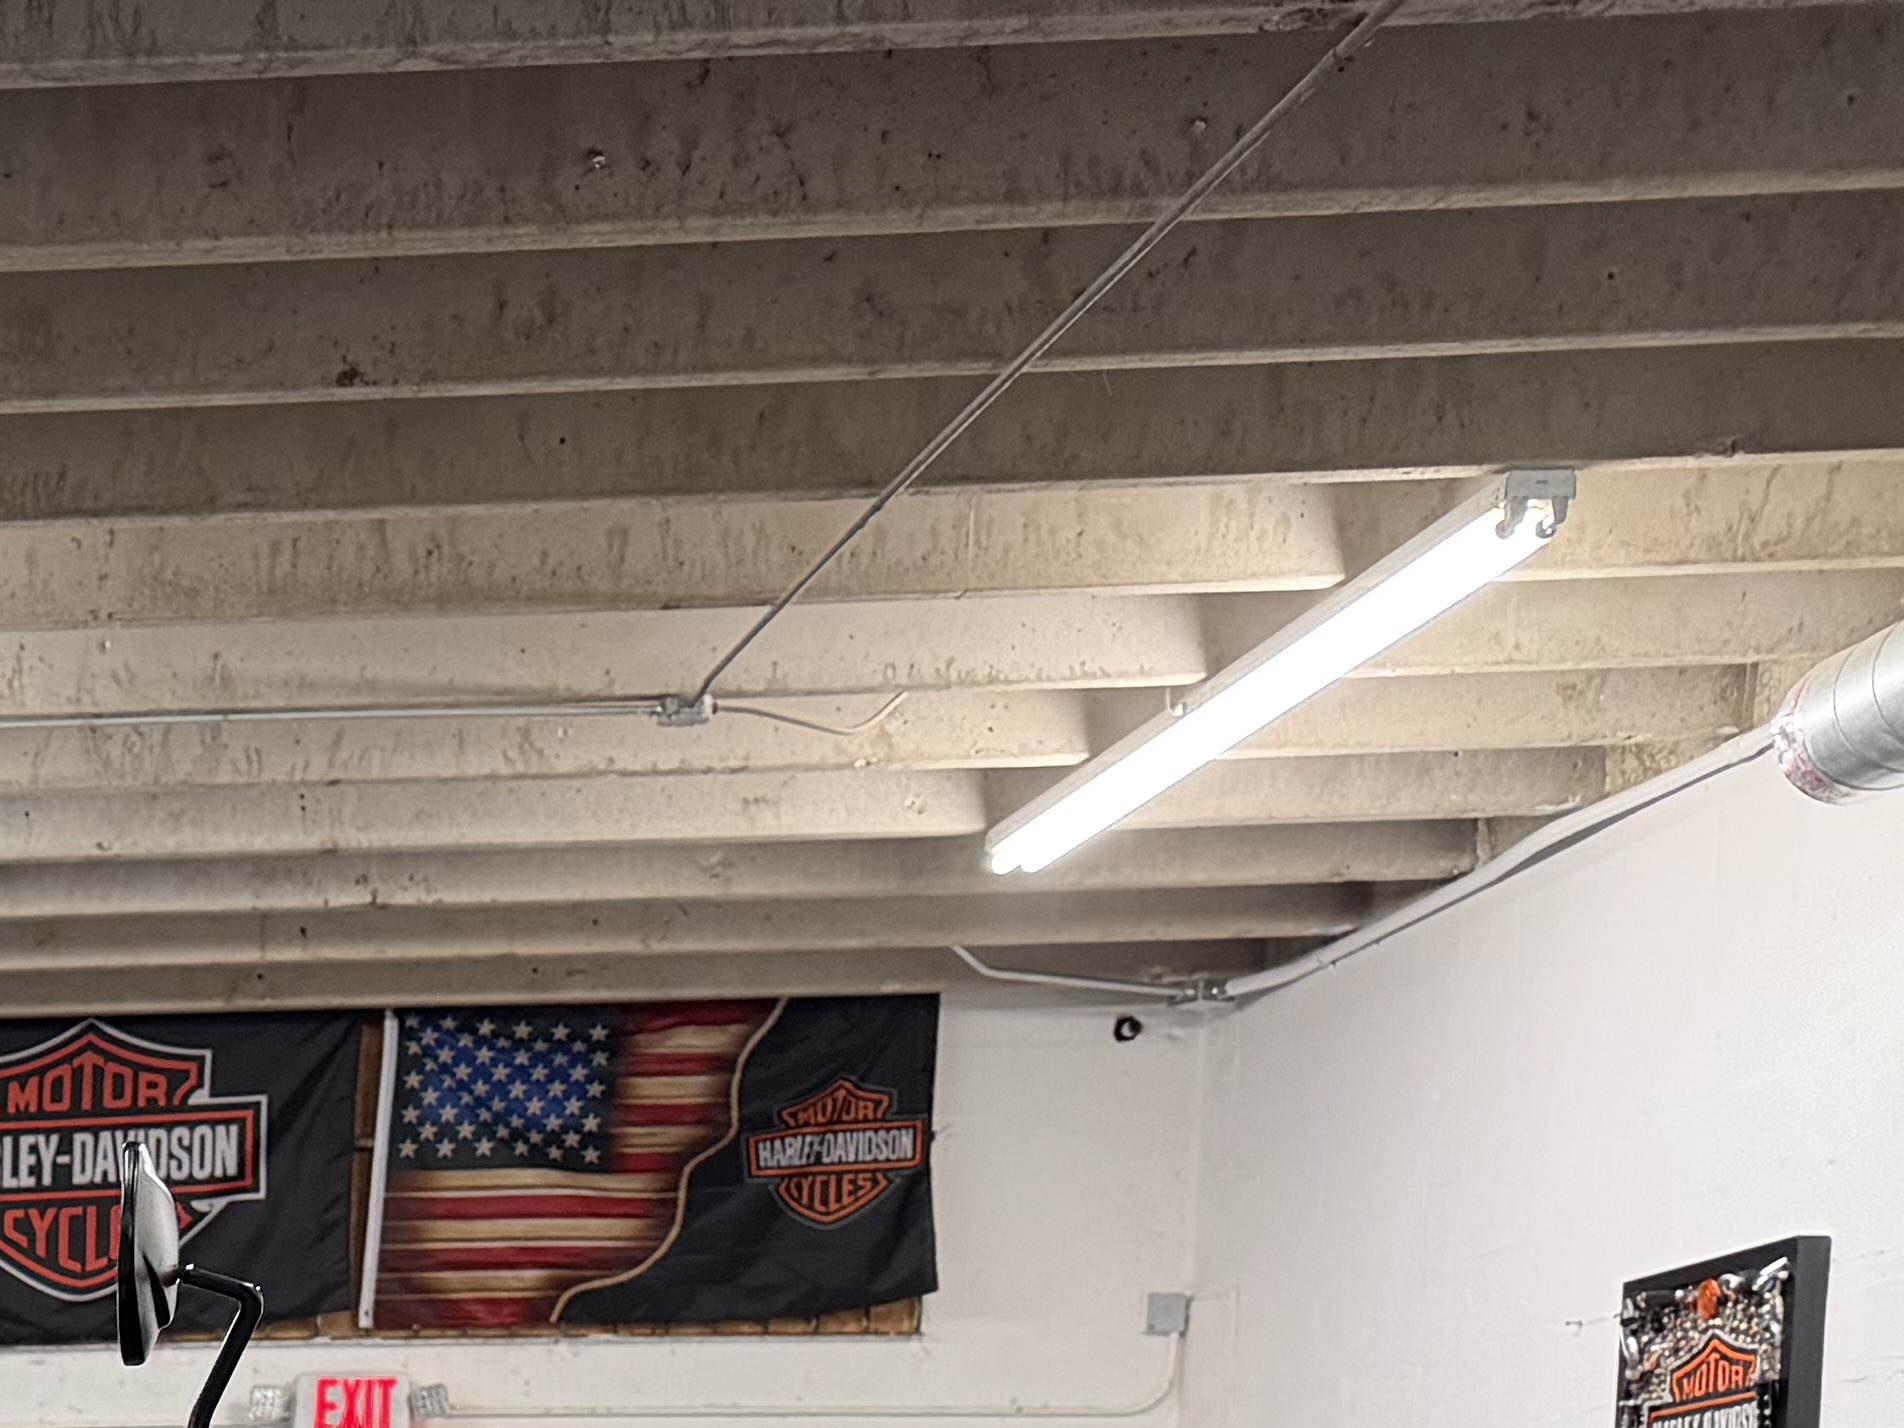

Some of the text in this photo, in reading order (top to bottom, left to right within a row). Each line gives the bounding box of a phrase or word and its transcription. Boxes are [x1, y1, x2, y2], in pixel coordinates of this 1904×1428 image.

[6, 1051, 169, 1115] MOTOR
[797, 1089, 875, 1125] MOTOR
[791, 1172, 873, 1213] CYCLES
[1682, 1352, 1744, 1401] MOTOR
